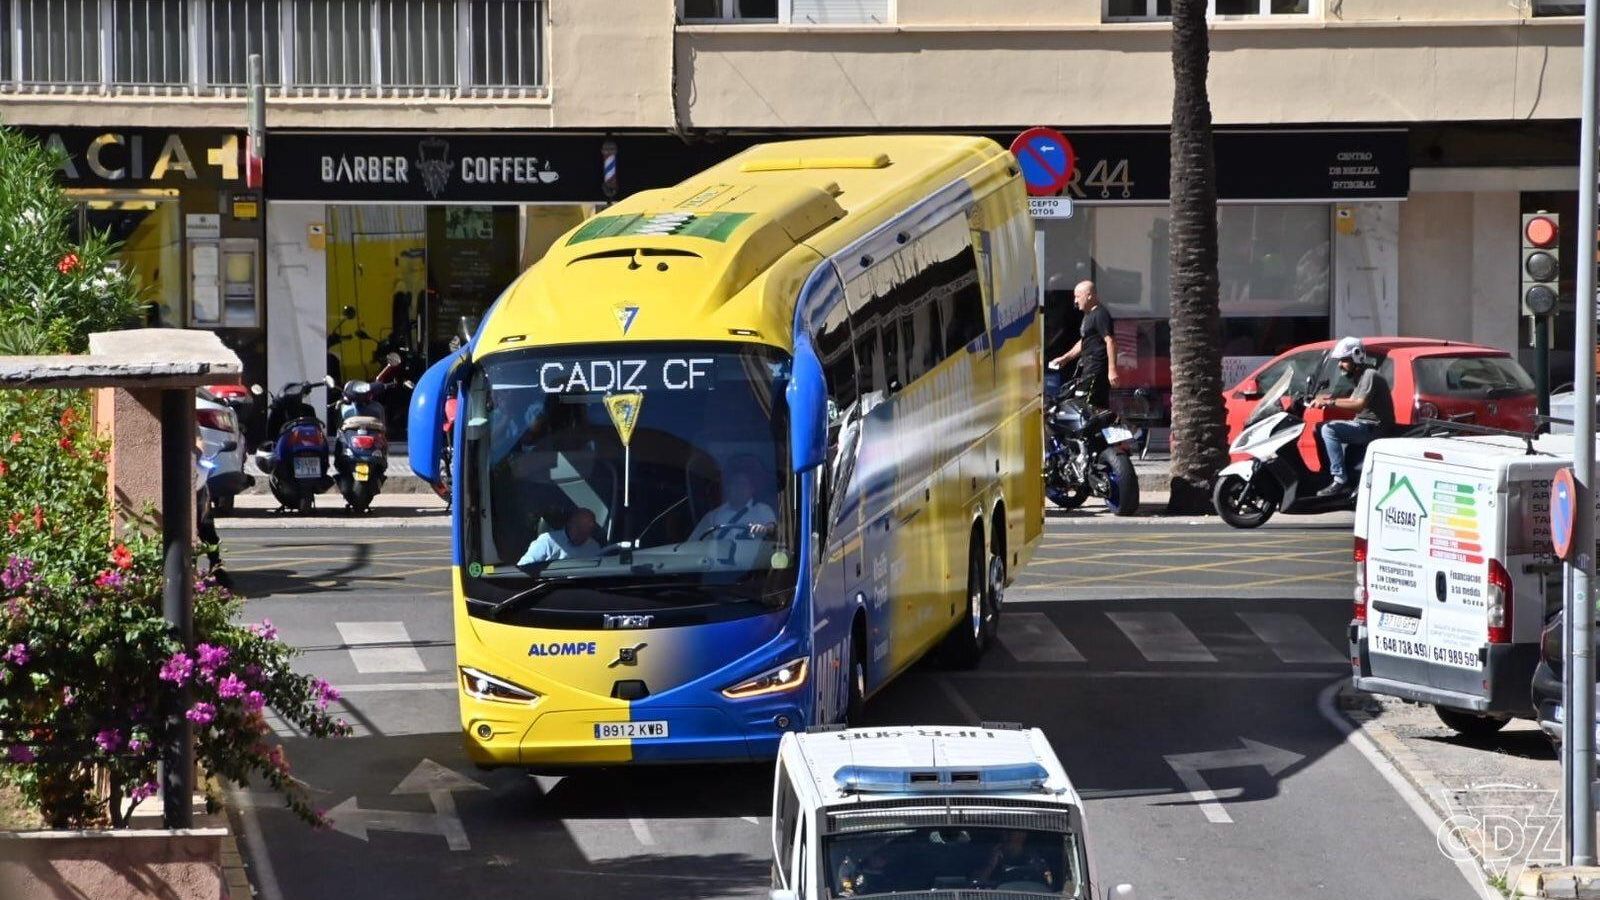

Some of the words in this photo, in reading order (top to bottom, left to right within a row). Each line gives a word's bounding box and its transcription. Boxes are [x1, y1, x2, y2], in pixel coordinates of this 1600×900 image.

[1337, 152, 1373, 161] CENTRO
[321, 154, 409, 183] BARBER
[461, 156, 539, 184] COFFEE
[1328, 166, 1342, 175] DE
[1342, 166, 1380, 175] BELLEZA
[1332, 180, 1377, 189] INTEGRAL
[540, 359, 647, 393] CADIZ
[662, 357, 714, 390] CF
[528, 642, 596, 657] ALOMPE
[602, 725, 635, 737] 8912
[639, 724, 664, 736] KWB
